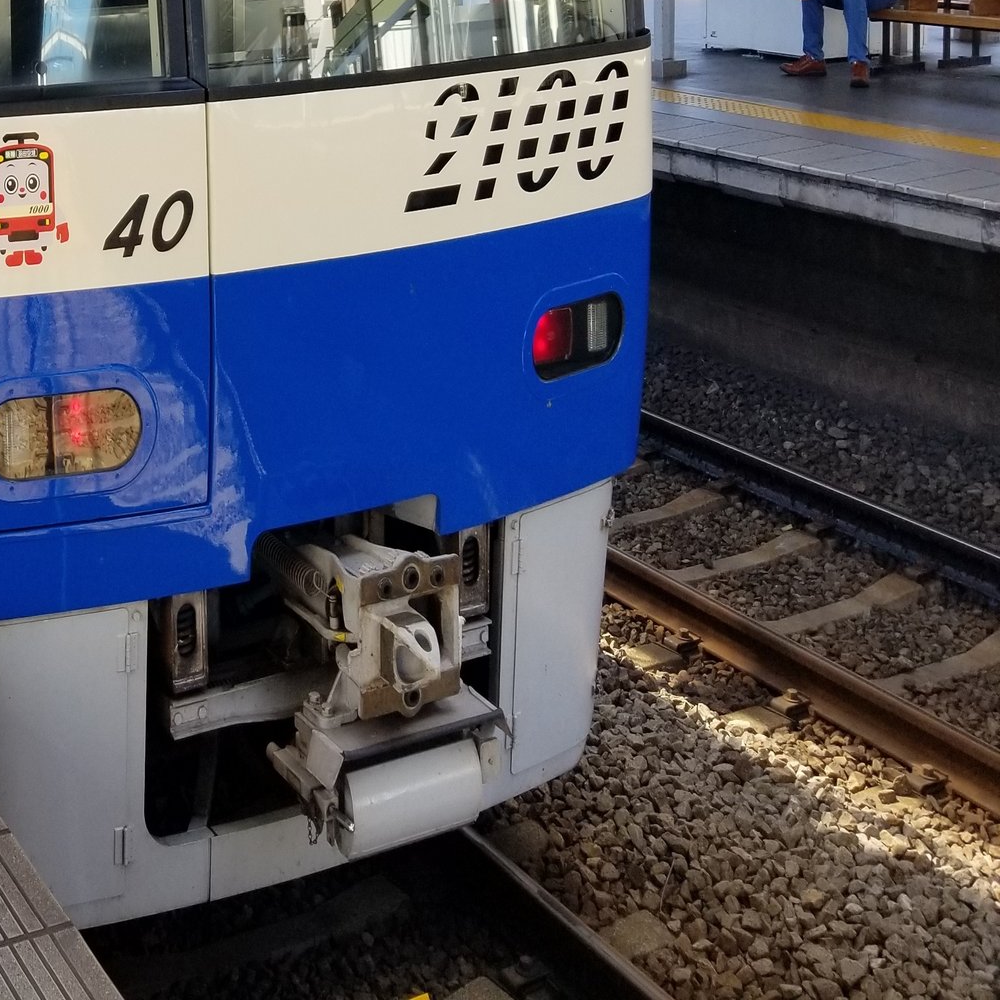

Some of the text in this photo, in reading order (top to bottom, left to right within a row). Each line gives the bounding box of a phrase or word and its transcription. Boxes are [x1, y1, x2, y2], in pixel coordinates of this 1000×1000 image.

[404, 60, 631, 213] 2100
[29, 205, 50, 215] 1000
[102, 190, 194, 258] 40
